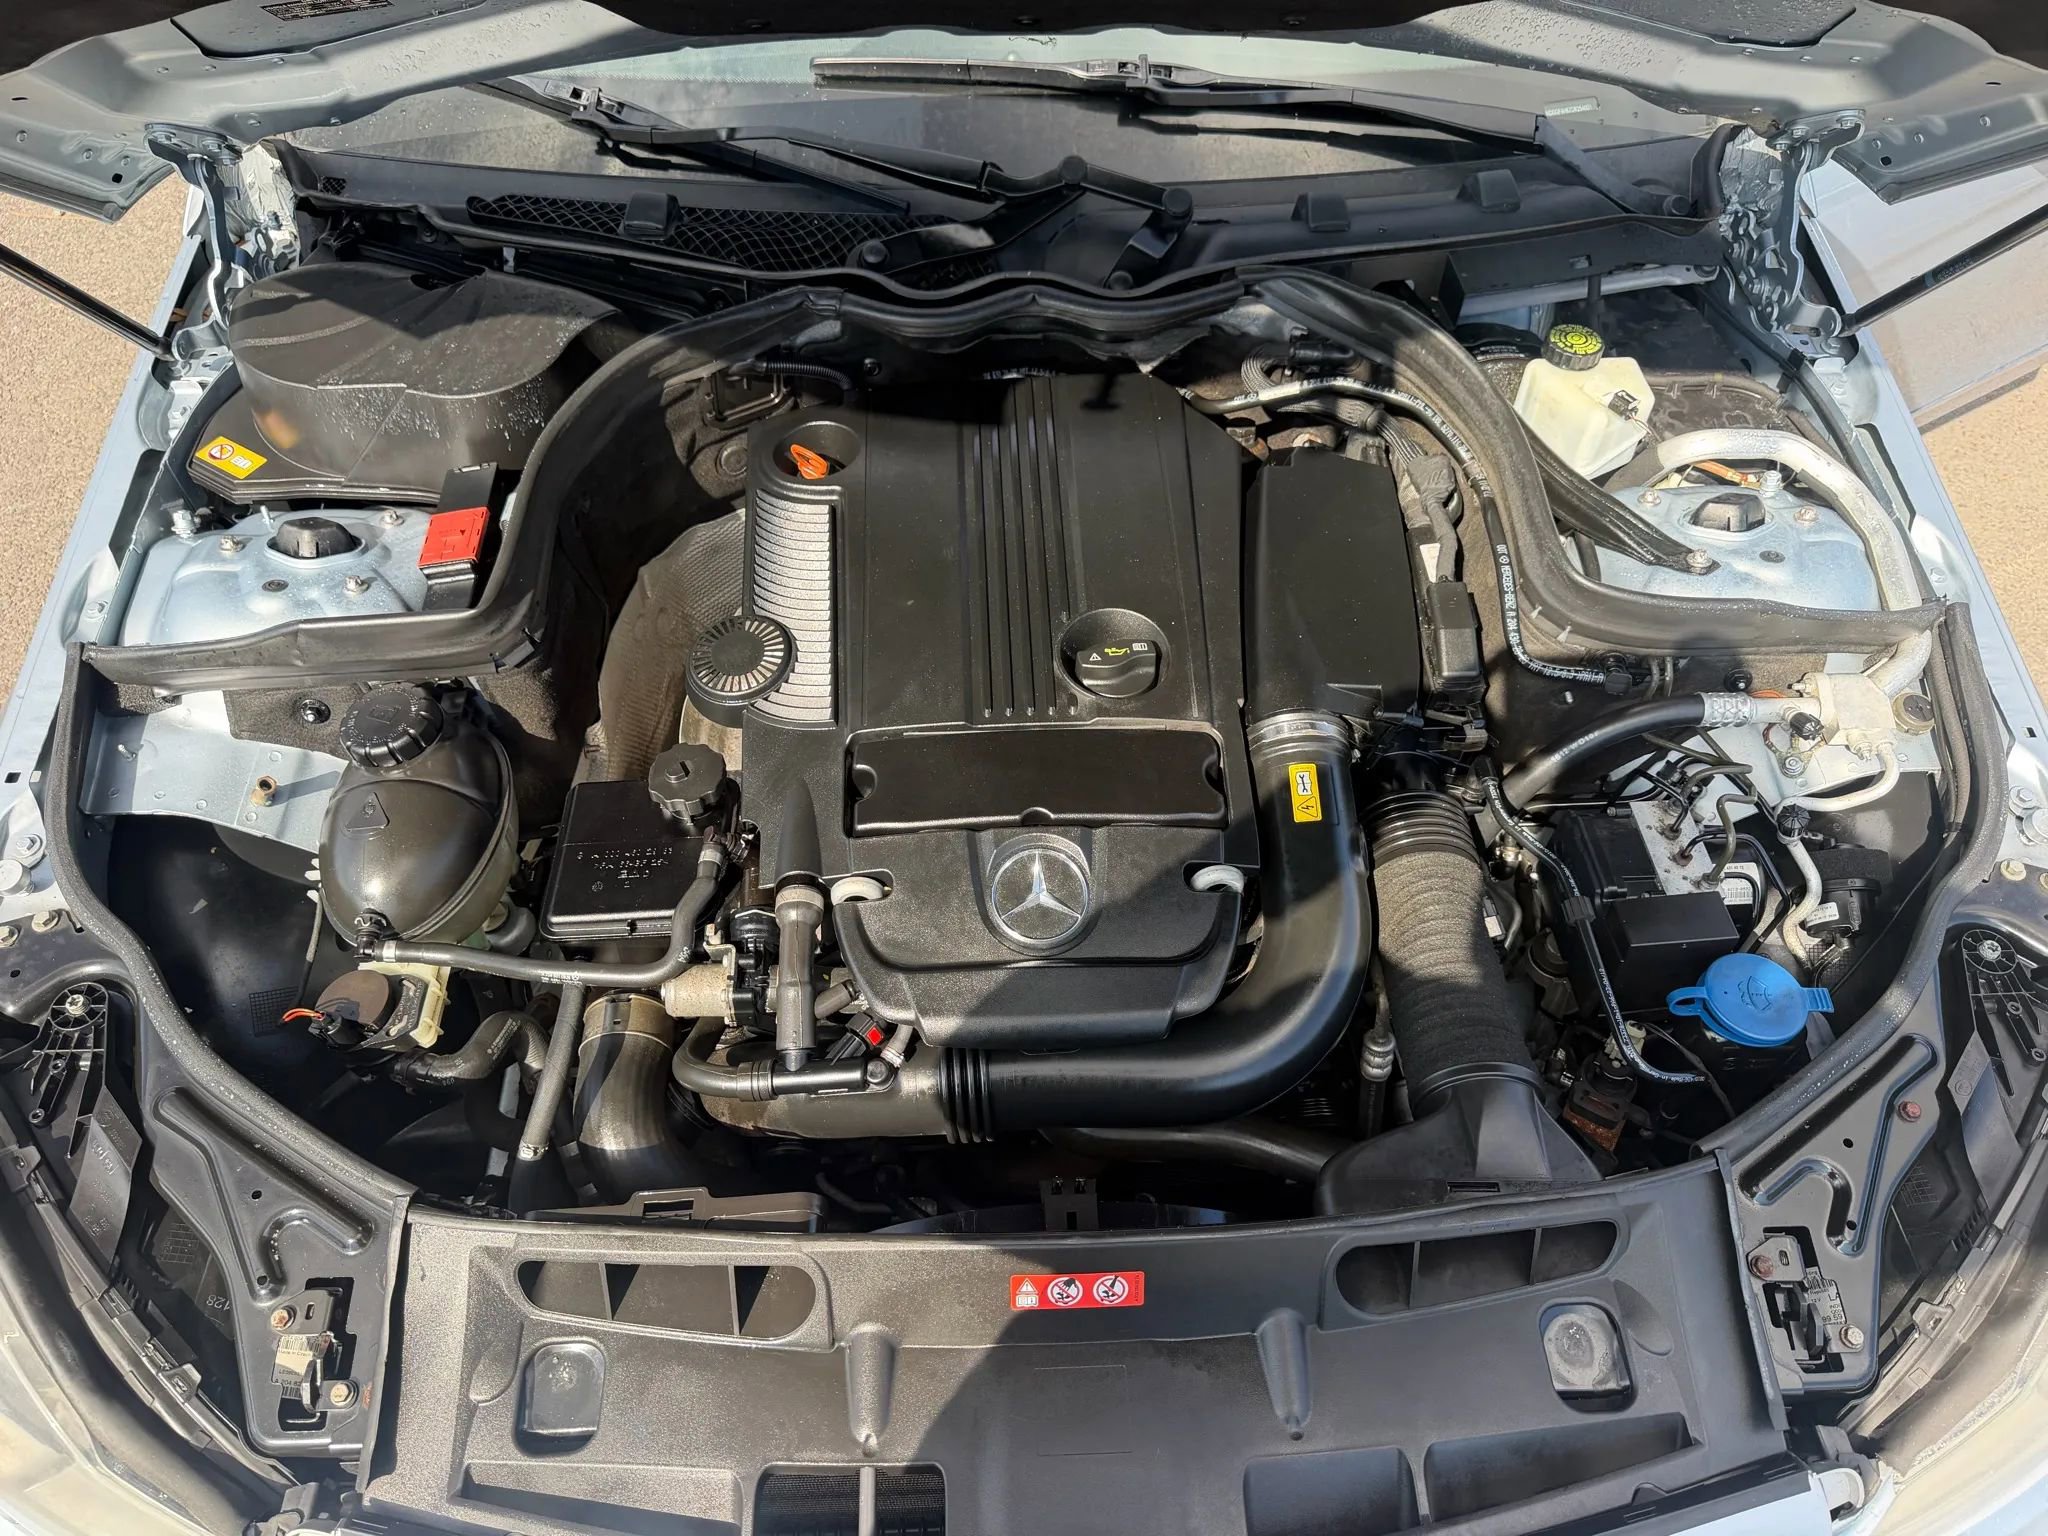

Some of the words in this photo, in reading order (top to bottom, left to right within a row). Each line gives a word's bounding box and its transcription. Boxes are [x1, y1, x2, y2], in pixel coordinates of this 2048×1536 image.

[1501, 565, 1517, 609] MERCEDES-BENZ
[1506, 617, 1518, 630] 204
[206, 1294, 231, 1310] 128
